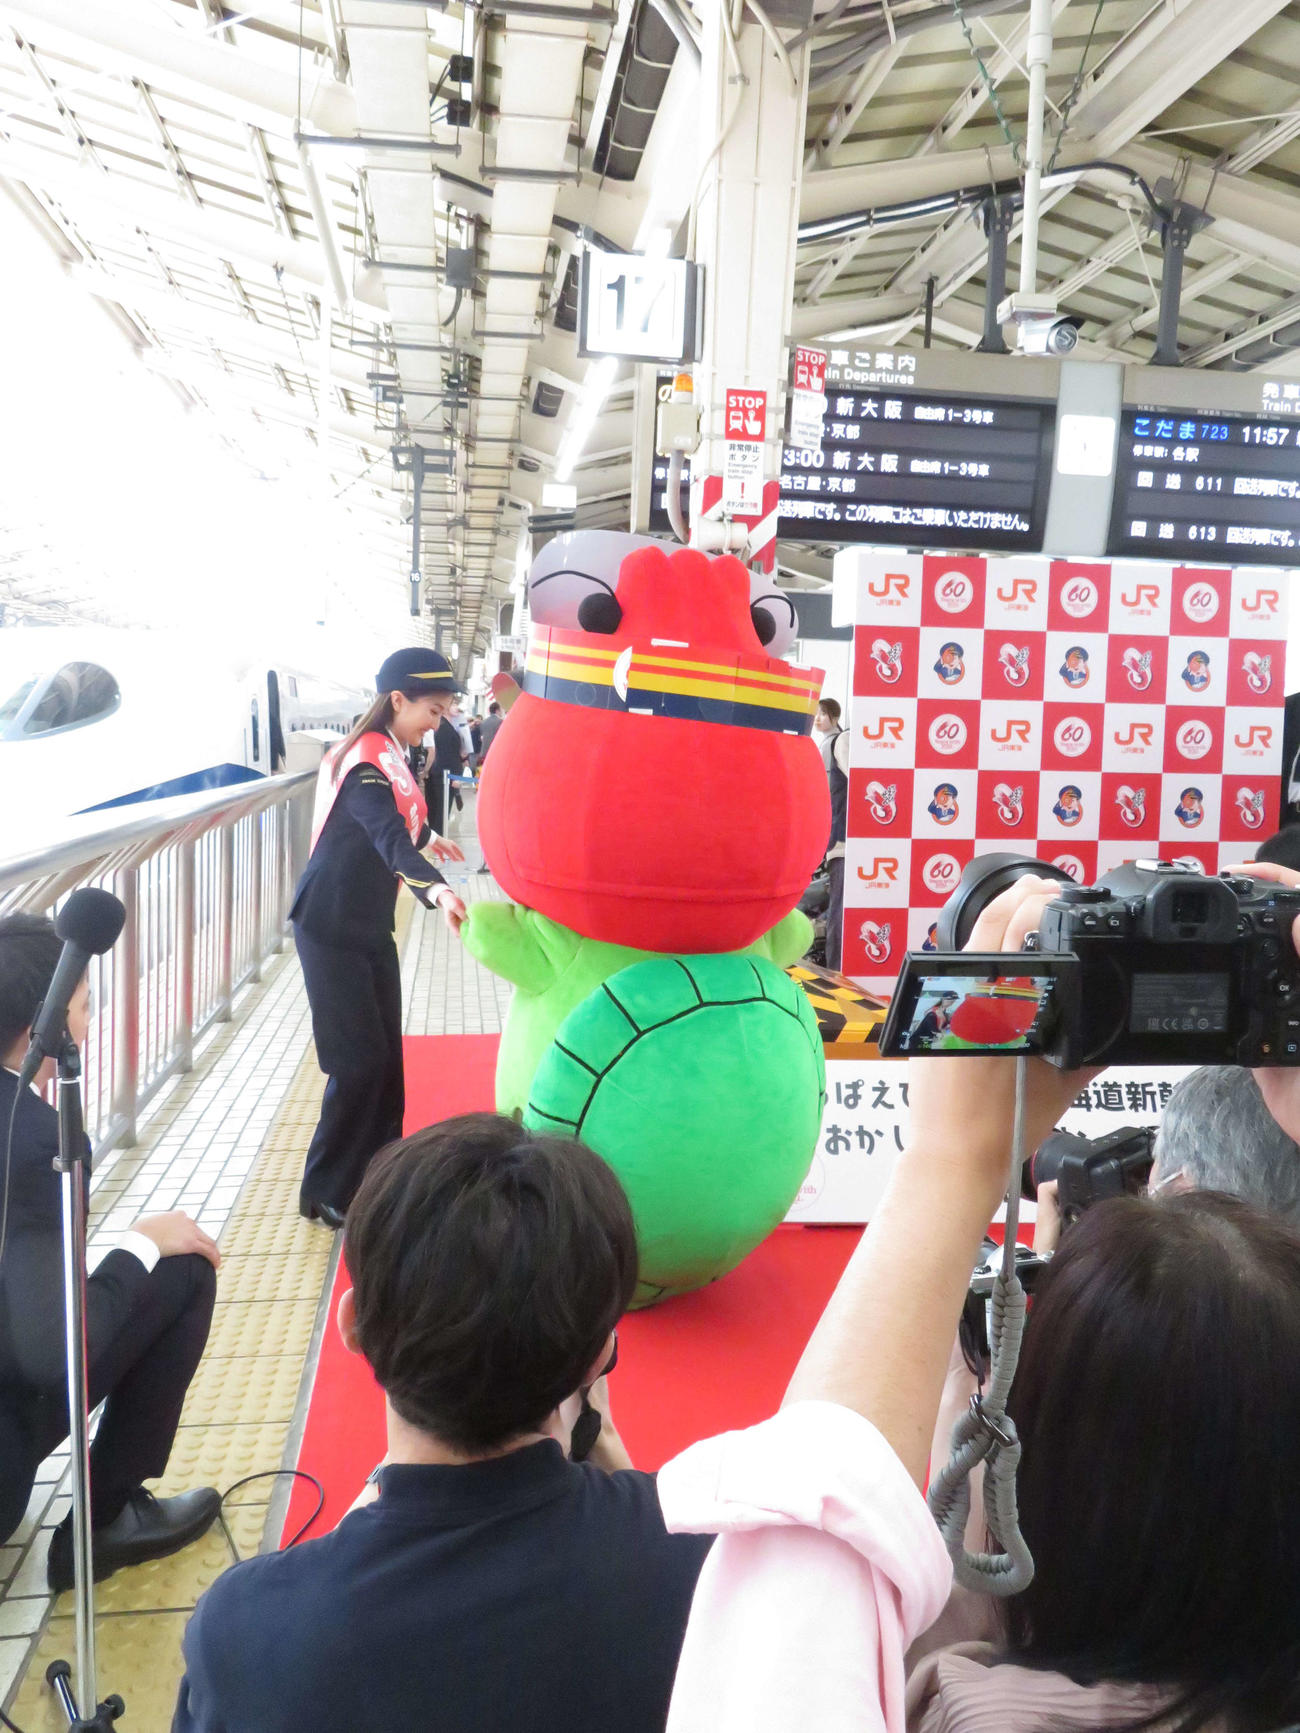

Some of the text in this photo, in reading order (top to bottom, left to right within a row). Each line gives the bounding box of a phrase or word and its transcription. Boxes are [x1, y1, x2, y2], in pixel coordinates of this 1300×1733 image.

[606, 274, 667, 333] 17
[797, 350, 826, 366] STOP
[830, 350, 916, 371] 車ご案内
[844, 368, 915, 385] Departures
[728, 396, 764, 409] STOP
[836, 397, 902, 420] 新大阪
[1262, 399, 1291, 413] Train
[821, 422, 860, 440] ・京都
[1134, 417, 1290, 446] こだま 723 11:57
[832, 450, 898, 473] 新大阪
[1195, 475, 1222, 492] 611
[1189, 525, 1217, 541] 613
[868, 573, 910, 598] JR
[941, 578, 966, 597] 60
[997, 579, 1038, 603] JR
[1067, 584, 1090, 602] 60
[1121, 584, 1160, 608] JR
[1189, 591, 1212, 607] 60
[1241, 589, 1279, 612] JR
[863, 717, 904, 740] JR
[935, 721, 959, 739] 60
[991, 720, 1031, 743] JR
[1061, 724, 1084, 742] 60
[1114, 723, 1153, 746] JR
[1183, 727, 1205, 744] 60
[1234, 726, 1272, 748] JR
[857, 857, 899, 880] JR
[930, 861, 954, 879] 60
